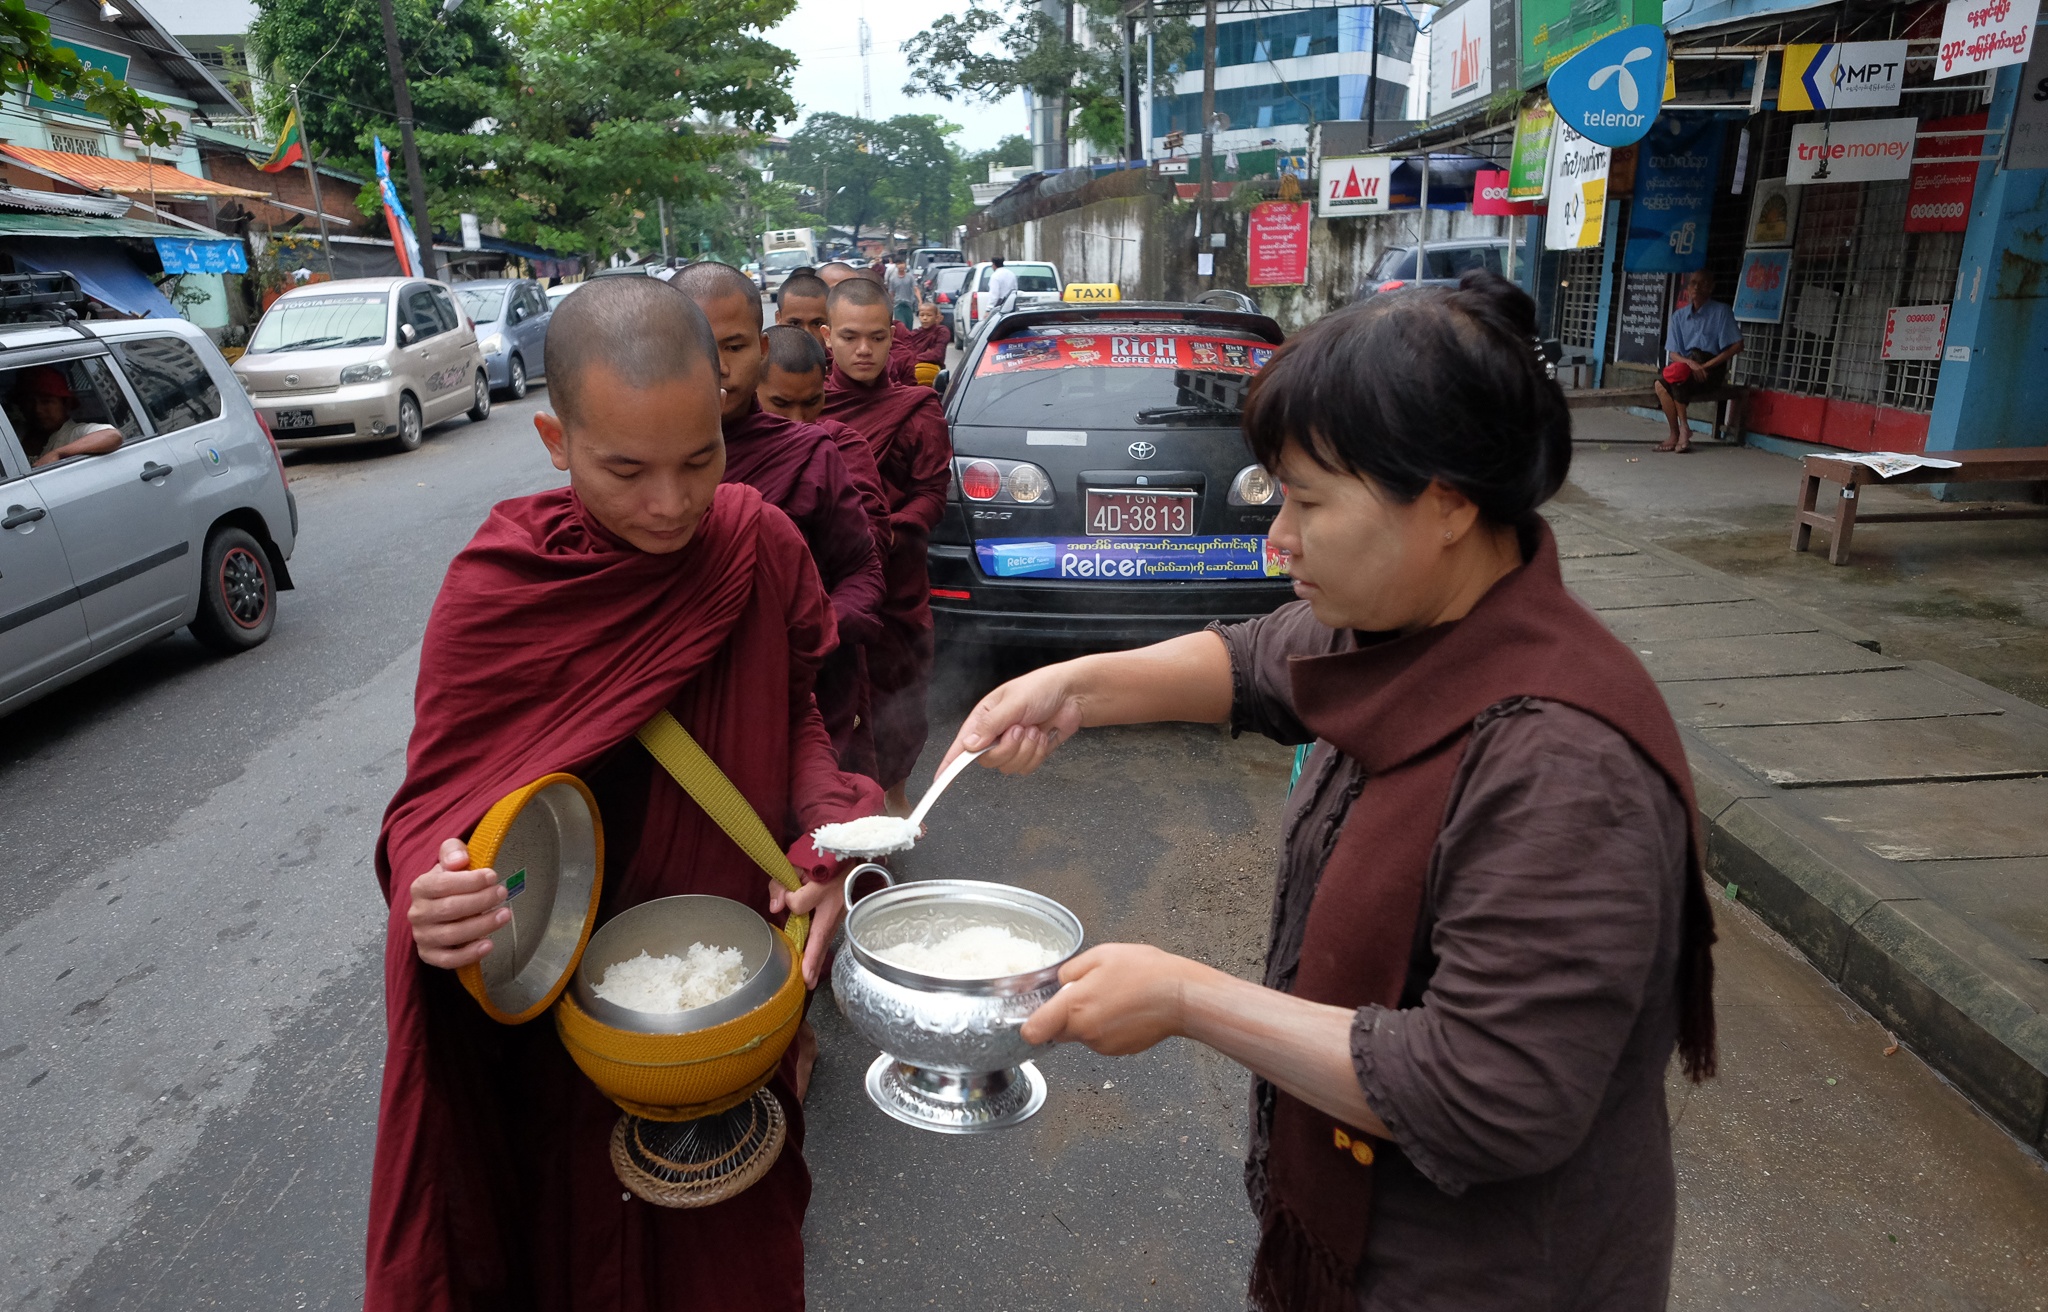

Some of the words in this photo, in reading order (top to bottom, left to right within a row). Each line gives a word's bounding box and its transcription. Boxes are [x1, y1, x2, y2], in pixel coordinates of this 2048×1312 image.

[1847, 63, 1898, 83] MPT
[1584, 109, 1645, 127] telenor
[1330, 164, 1380, 199] ZAW
[1911, 202, 1964, 219] ooredoo
[1073, 288, 1111, 298] TAXI
[284, 300, 324, 310] TOYOTA
[1111, 356, 1150, 364] COFFEE
[1154, 357, 1178, 365] MIX
[1125, 495, 1157, 504] YGN
[1093, 506, 1185, 531] 4D-3813
[1008, 556, 1036, 567] Relcer
[1061, 553, 1146, 577] Relcer
